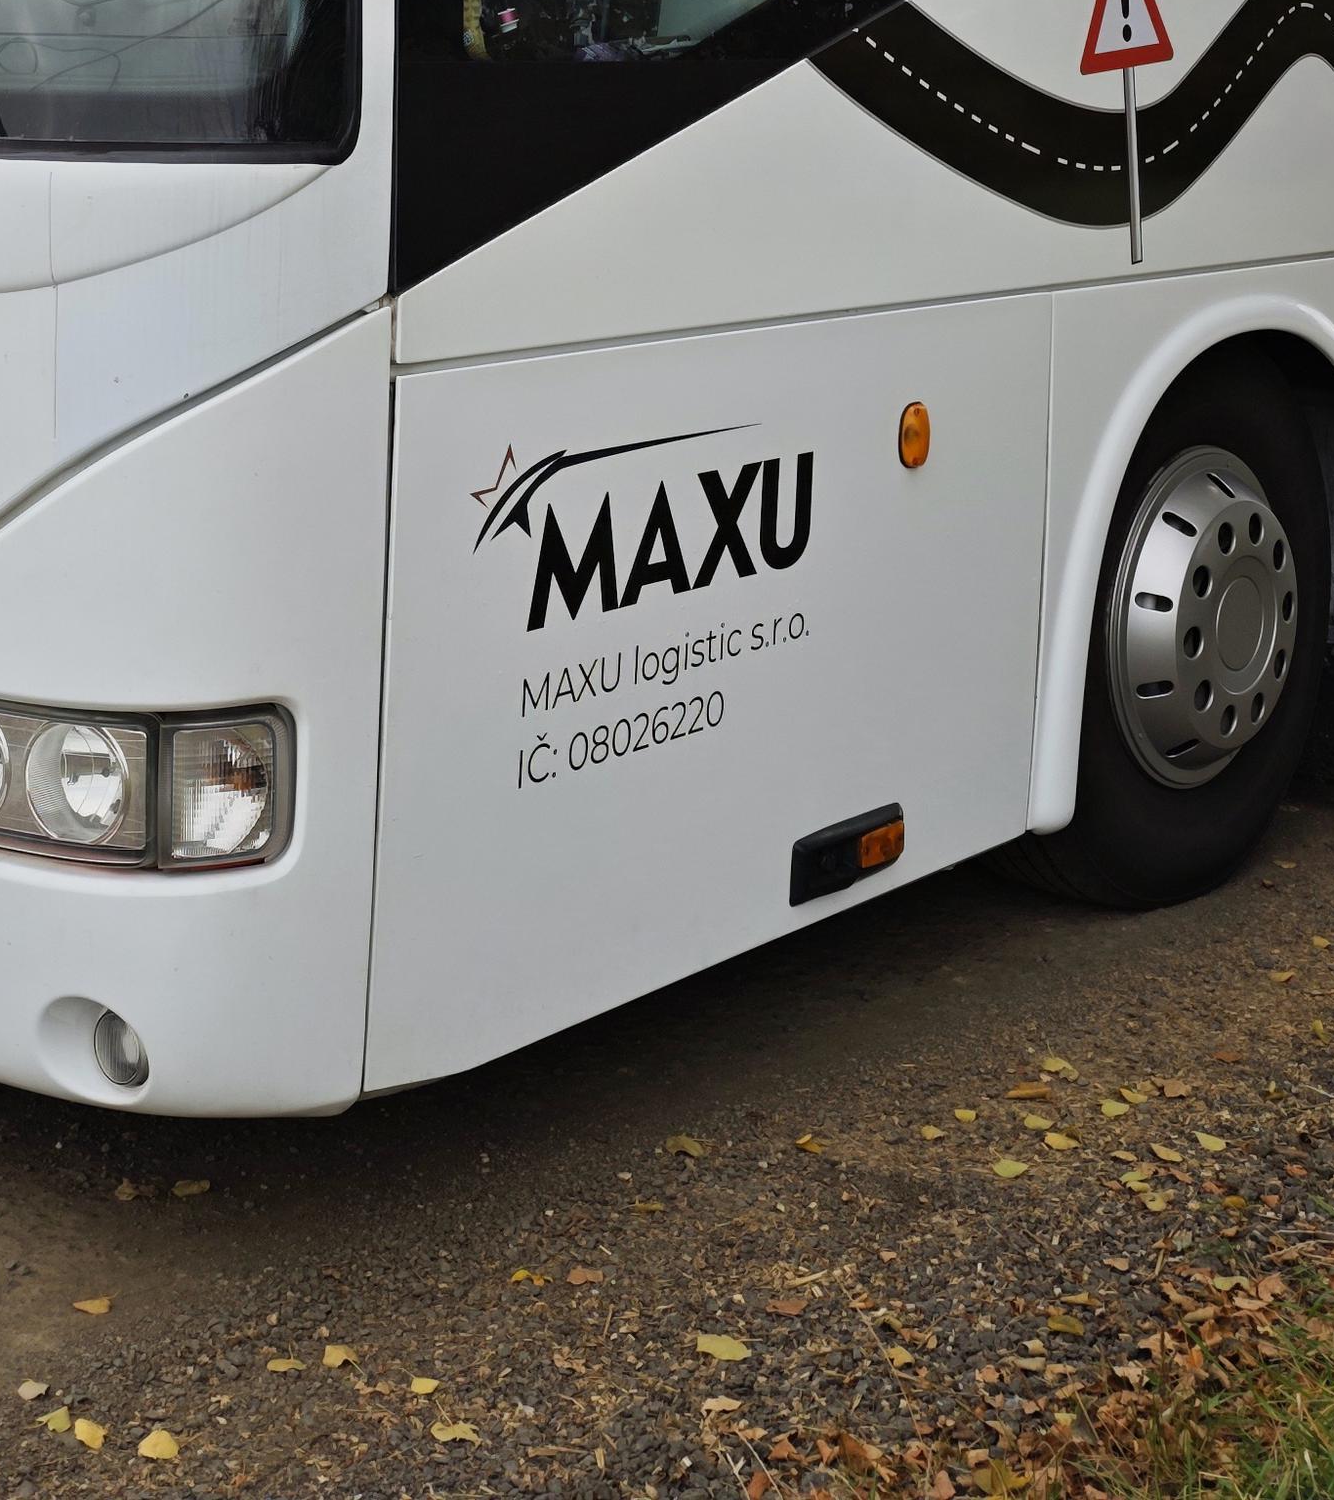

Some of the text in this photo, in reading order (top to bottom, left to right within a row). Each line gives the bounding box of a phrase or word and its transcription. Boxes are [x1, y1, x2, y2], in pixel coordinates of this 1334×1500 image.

[526, 451, 814, 632] MAXU
[521, 612, 810, 718] MAXU logistic s.r.o.
[517, 690, 725, 789] IČ: 08026220
